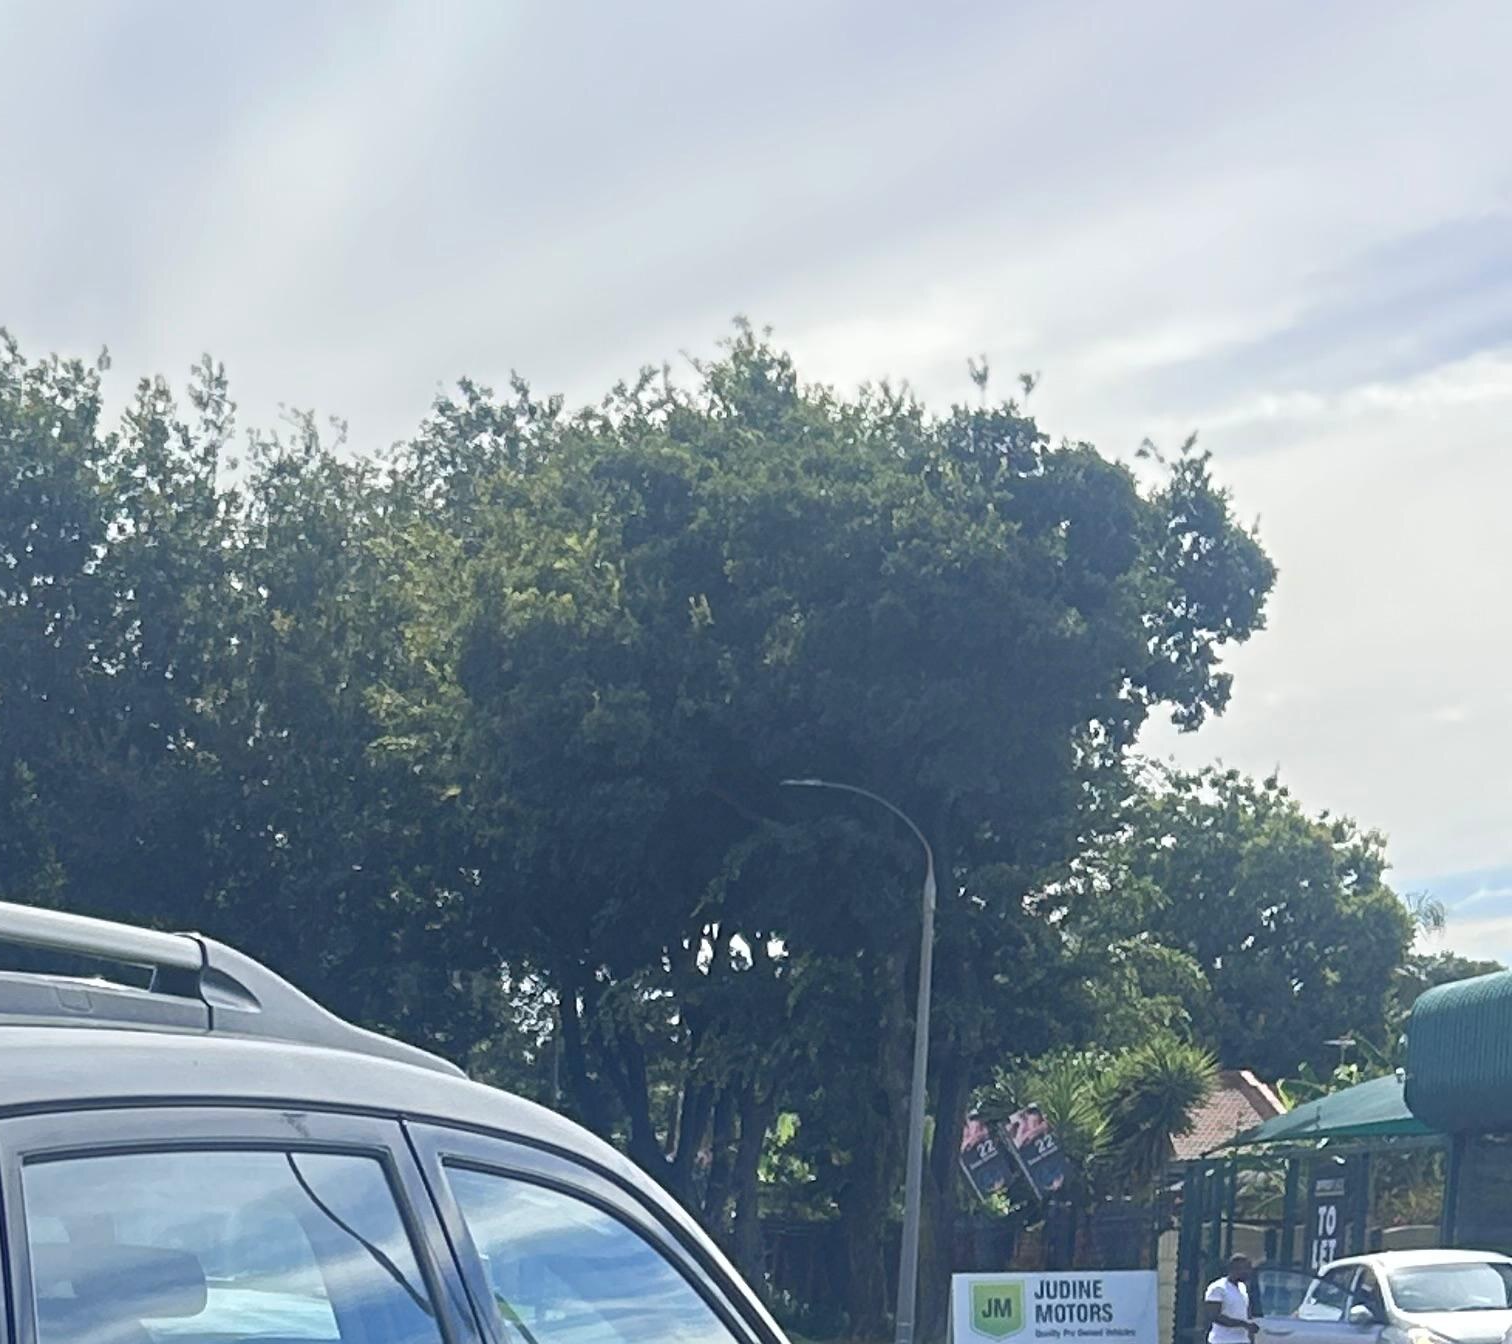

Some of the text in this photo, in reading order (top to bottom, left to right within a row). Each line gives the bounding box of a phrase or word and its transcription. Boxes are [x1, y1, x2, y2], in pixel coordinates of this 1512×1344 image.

[1317, 1205, 1337, 1236] TO
[1311, 1239, 1337, 1269] LET
[1034, 1280, 1104, 1300] JUDINE
[981, 1297, 1013, 1319] JM
[1035, 1302, 1114, 1324] MOTORS
